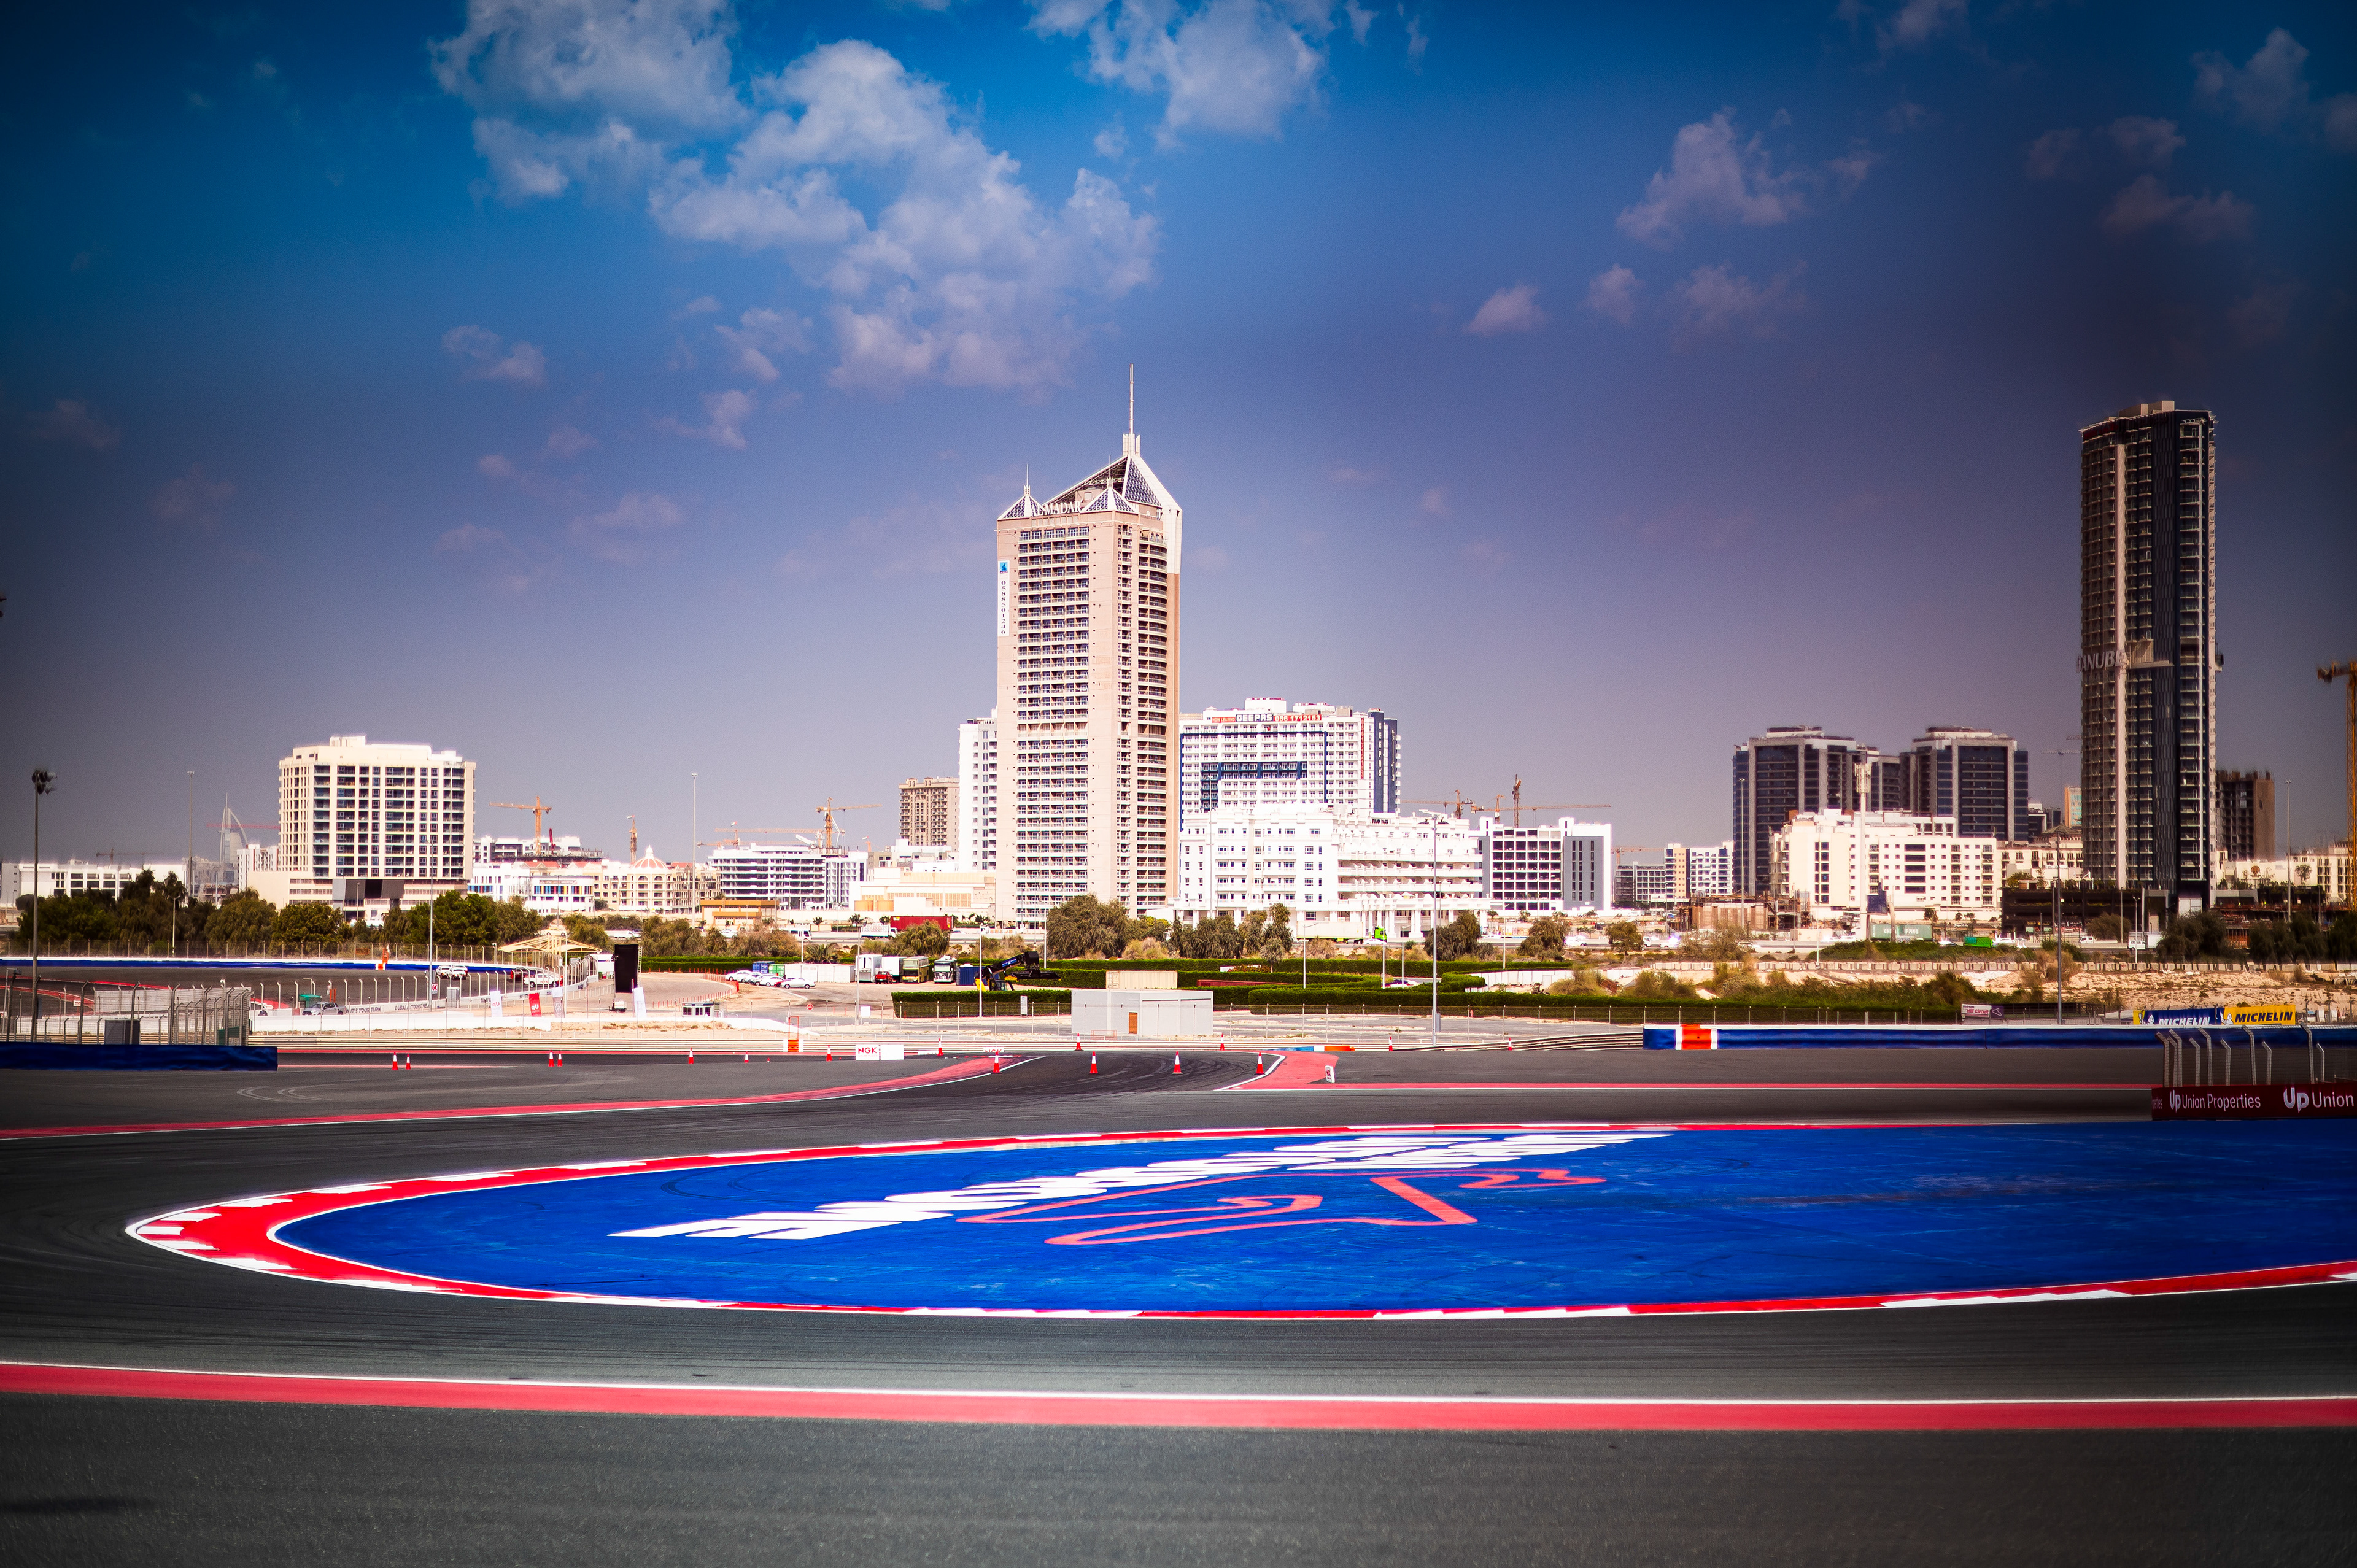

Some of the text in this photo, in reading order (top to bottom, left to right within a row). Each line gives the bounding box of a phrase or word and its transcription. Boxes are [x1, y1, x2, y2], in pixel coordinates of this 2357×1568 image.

[2159, 1017, 2211, 1025] MICHELIN
[2235, 1011, 2293, 1023] MICHELIN
[2182, 1094, 2205, 1109] Union
[2207, 1094, 2261, 1111] Properties
[2312, 1092, 2355, 1108] Union
